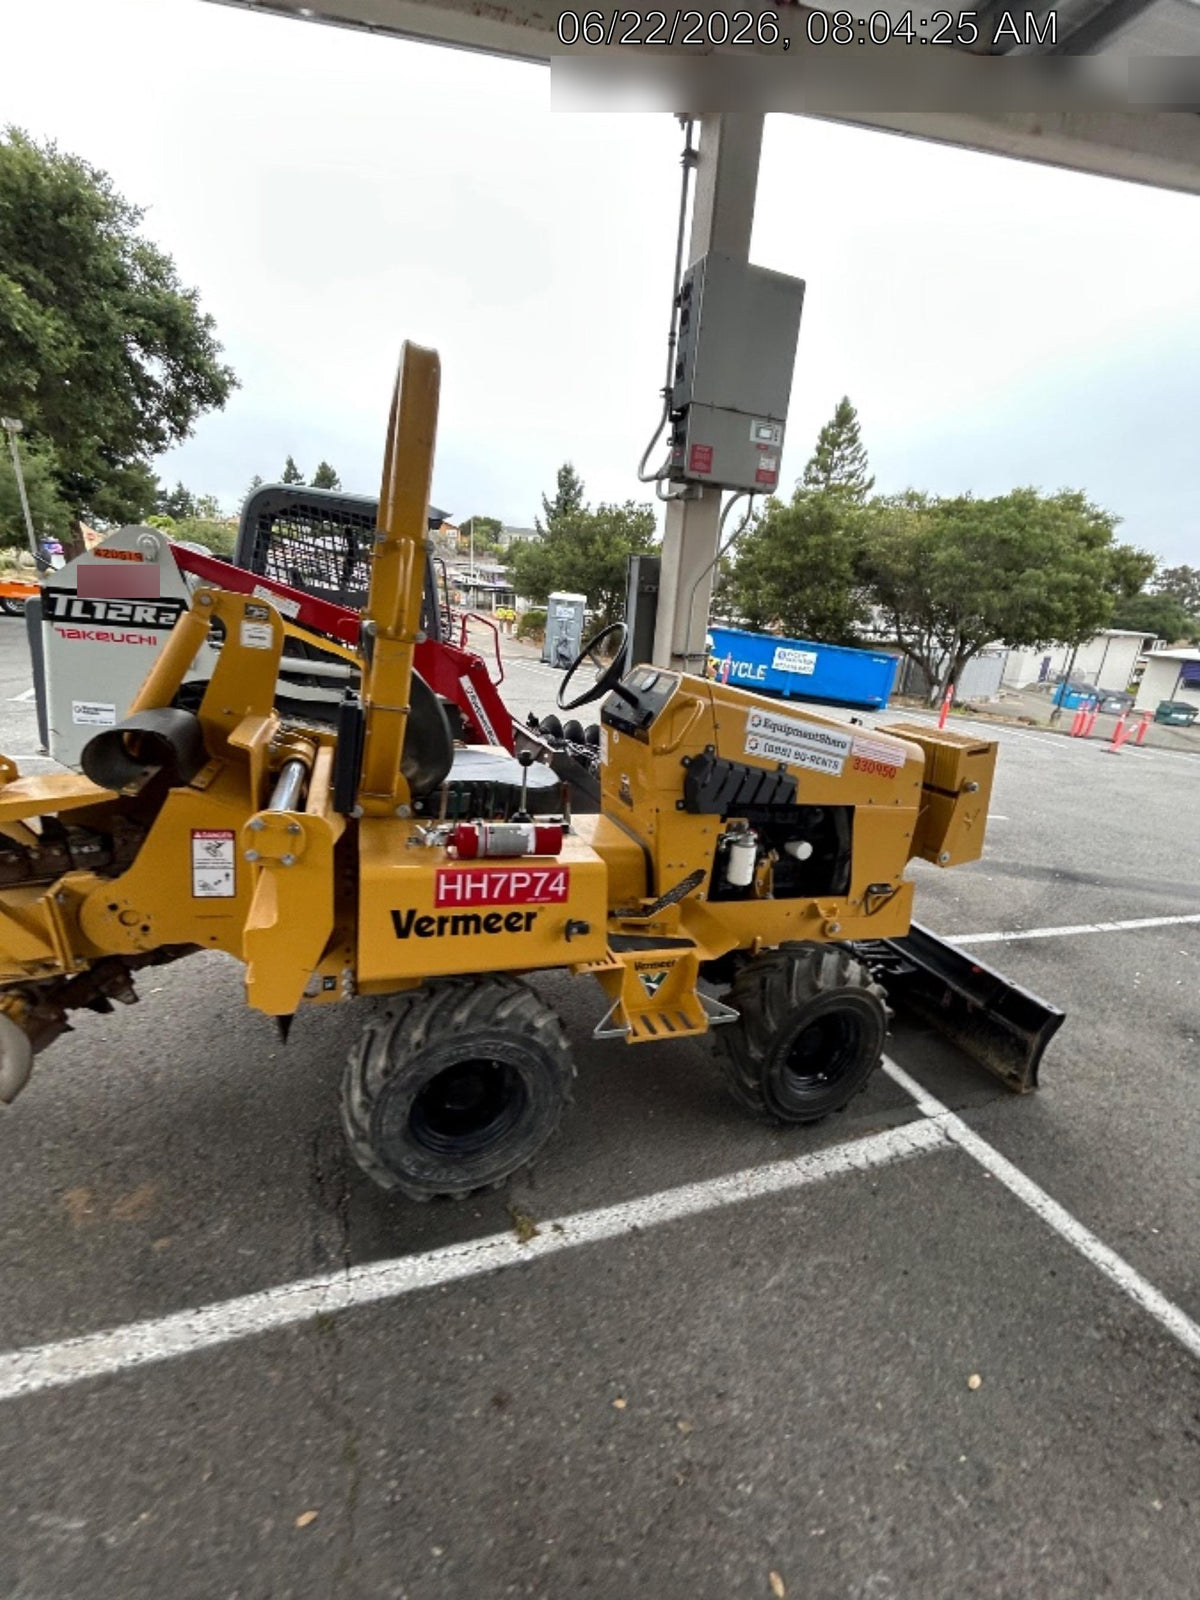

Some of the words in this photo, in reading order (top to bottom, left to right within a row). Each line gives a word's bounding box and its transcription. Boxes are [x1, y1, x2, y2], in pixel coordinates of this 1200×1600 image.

[763, 717, 847, 750] EquipmentShare
[438, 872, 566, 900] HH7P74
[391, 909, 537, 939] Vermeer
[635, 960, 676, 971] Vermeer
